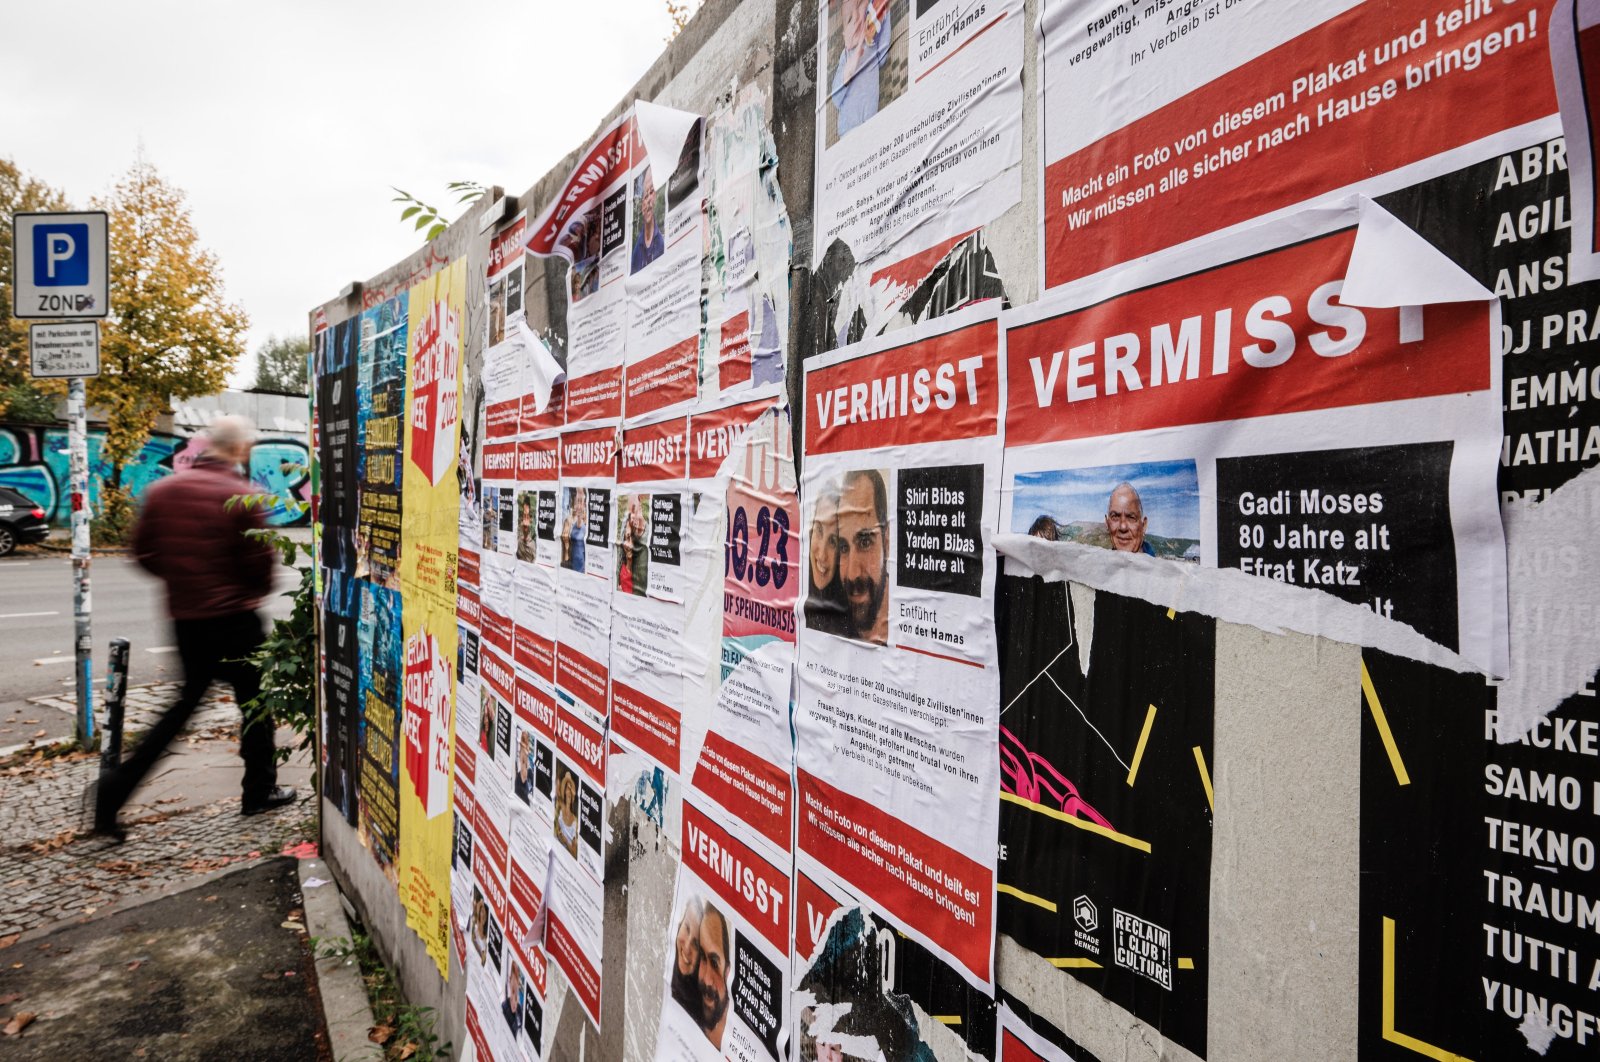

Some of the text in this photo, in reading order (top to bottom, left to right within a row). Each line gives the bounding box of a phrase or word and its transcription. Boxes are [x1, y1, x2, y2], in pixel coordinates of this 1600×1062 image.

[919, 4, 960, 47] Entführt
[919, 4, 986, 62] von der Hamas
[1087, 3, 1128, 37] Frauen,
[1131, 49, 1146, 66] Ihr
[1150, 16, 1199, 53] Verbleib
[1204, 3, 1220, 22] ist
[1069, 14, 1140, 66] vergewaltigt,
[905, 108, 945, 138] unschuldige
[1062, 0, 1493, 208] Macht ein Foto von diesem Plakat und teilt
[1067, 8, 1537, 231] Wir müssen alle sicher nach Hause bringen!
[922, 143, 958, 169] Menschen
[964, 133, 1000, 159] von ihren
[1494, 137, 1568, 192] ABR
[1493, 196, 1572, 248] AGIL
[46, 233, 76, 278] P
[816, 354, 984, 429] VERMISST
[485, 452, 515, 470] VERMISST
[519, 449, 556, 470] VERMISST
[565, 441, 613, 465] VERMISST
[622, 434, 682, 468] VERMISST
[906, 487, 965, 506] Shiri Bibas
[1238, 489, 1383, 518] Gadi Moses
[906, 511, 966, 527] 33 Jahre alt
[1239, 522, 1390, 551] 80 Jahre alt
[724, 506, 789, 590] 0.23
[906, 532, 975, 553] Yarden Bibas
[905, 554, 965, 573] 34 Jahre alt
[1303, 558, 1361, 587] Katz
[735, 596, 796, 634] SPENDENBASIS
[900, 603, 937, 624] Entführt
[899, 622, 964, 645] von der Hamas
[517, 687, 553, 729] VERMISST
[861, 677, 873, 688] über
[875, 681, 884, 692] 200
[886, 687, 925, 707] unschuldige
[910, 708, 949, 728] verschleppt.
[557, 717, 603, 770] VERMISST
[858, 715, 965, 763] Kinder Menschen wurden
[879, 737, 979, 784] gefoltert und brutal von ihren
[741, 765, 785, 801] Plakat und teilt es!
[745, 784, 782, 816] Hause bringen!
[1485, 763, 1582, 811] SAMO
[805, 791, 980, 908] Macht ein Foto von diesem Plakat und teilt es!
[1484, 815, 1596, 872] TEKNO
[687, 821, 783, 925] VERMISST
[807, 809, 976, 928] Wir müssen alle sicher nach Hause bringen!
[1483, 869, 1600, 935] TRAUM
[1074, 930, 1100, 946] GERADE
[1074, 939, 1099, 955] DENKEN
[1116, 913, 1168, 949] RECLAIM
[1129, 935, 1159, 961] CLUB
[739, 947, 771, 989] Shiri Bibas
[1117, 947, 1169, 986] CULTURE
[1483, 922, 1578, 984] TUTTI
[738, 978, 777, 1029] Yarden Bibas
[739, 965, 772, 1006] 33 Jahre alt
[743, 1003, 759, 1028] Jahre
[759, 1021, 768, 1039] alt
[1482, 976, 1600, 1046] YUNGF
[732, 1027, 757, 1059] Entführt
